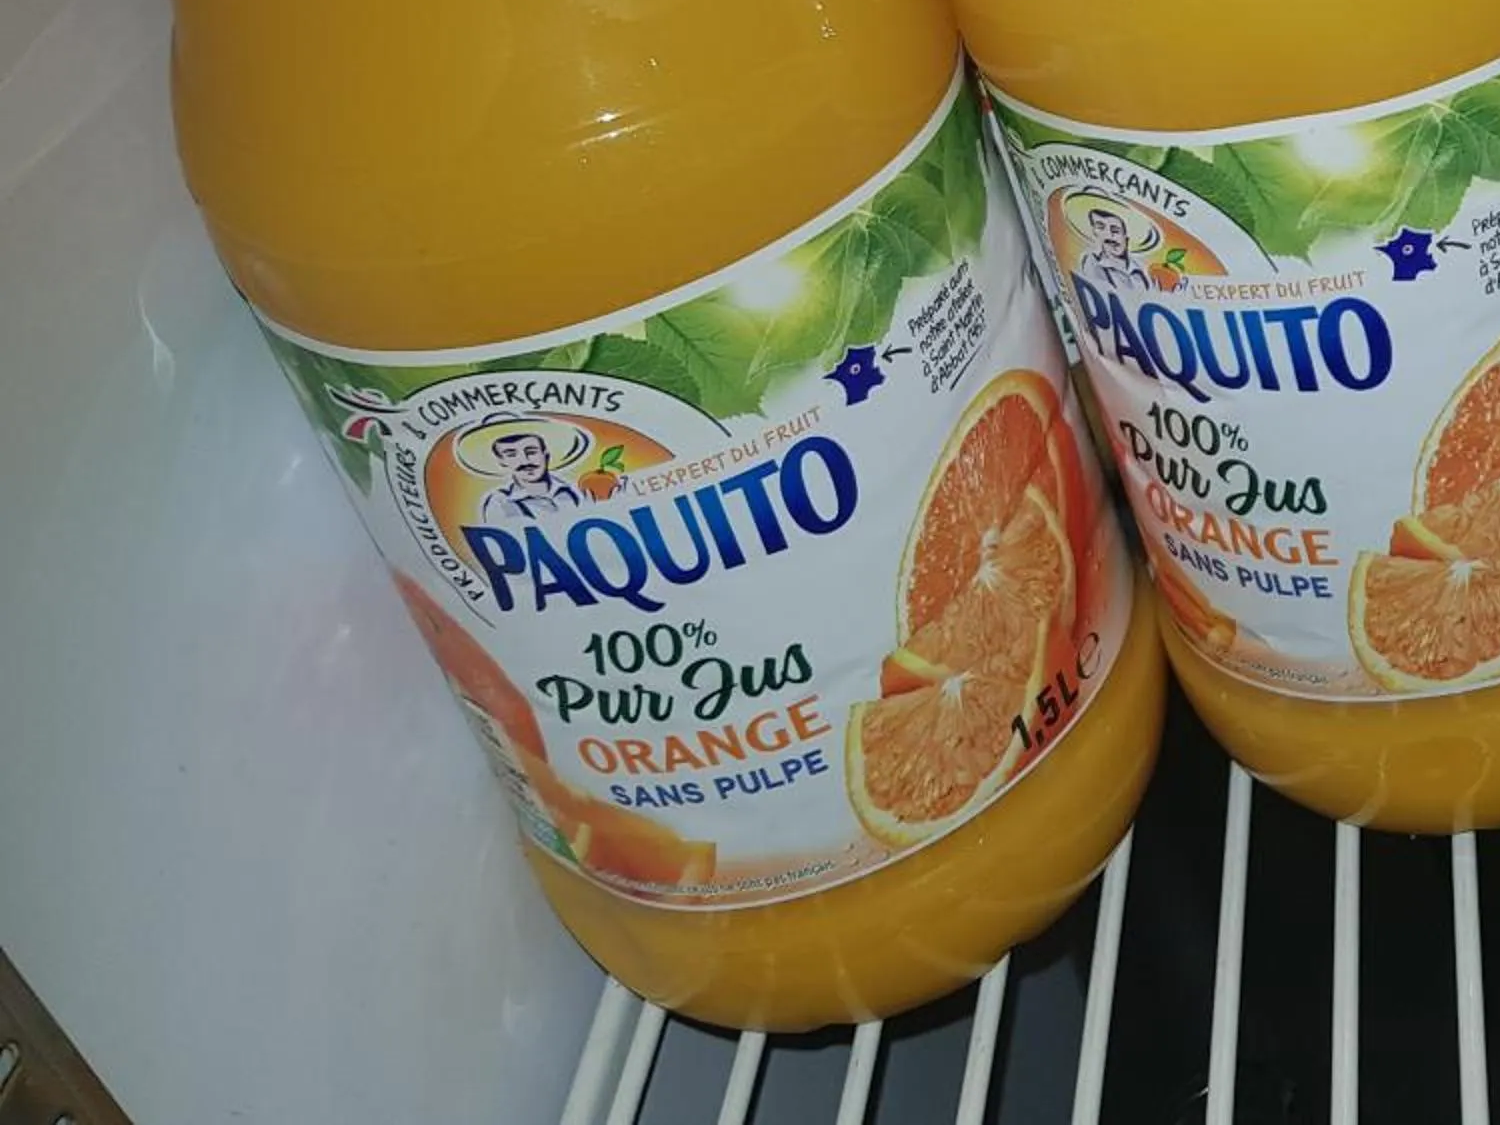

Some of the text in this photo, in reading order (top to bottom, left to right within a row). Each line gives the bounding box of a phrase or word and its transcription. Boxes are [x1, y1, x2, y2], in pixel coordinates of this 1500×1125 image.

[1040, 154, 1191, 218] COMMERÇANTS
[1190, 270, 1367, 301] L'EXPERT DU FRUIT
[1071, 271, 1393, 404] PAQUITO
[418, 381, 625, 427] COMMERÇANTS
[1147, 401, 1249, 456] 100%
[631, 405, 822, 496] L'EXPERT DU FRUIT
[1119, 420, 1328, 516] Pur Jus
[395, 442, 485, 602] PRODUCTEURS
[460, 435, 859, 613] PAQUITO
[1145, 477, 1339, 566] ORANGE
[1163, 532, 1333, 599] SANS PULPE
[536, 643, 813, 724] Pur Jus
[583, 618, 718, 676] 100%
[577, 694, 833, 774] ORANGE
[610, 749, 830, 808] SANS PULPE
